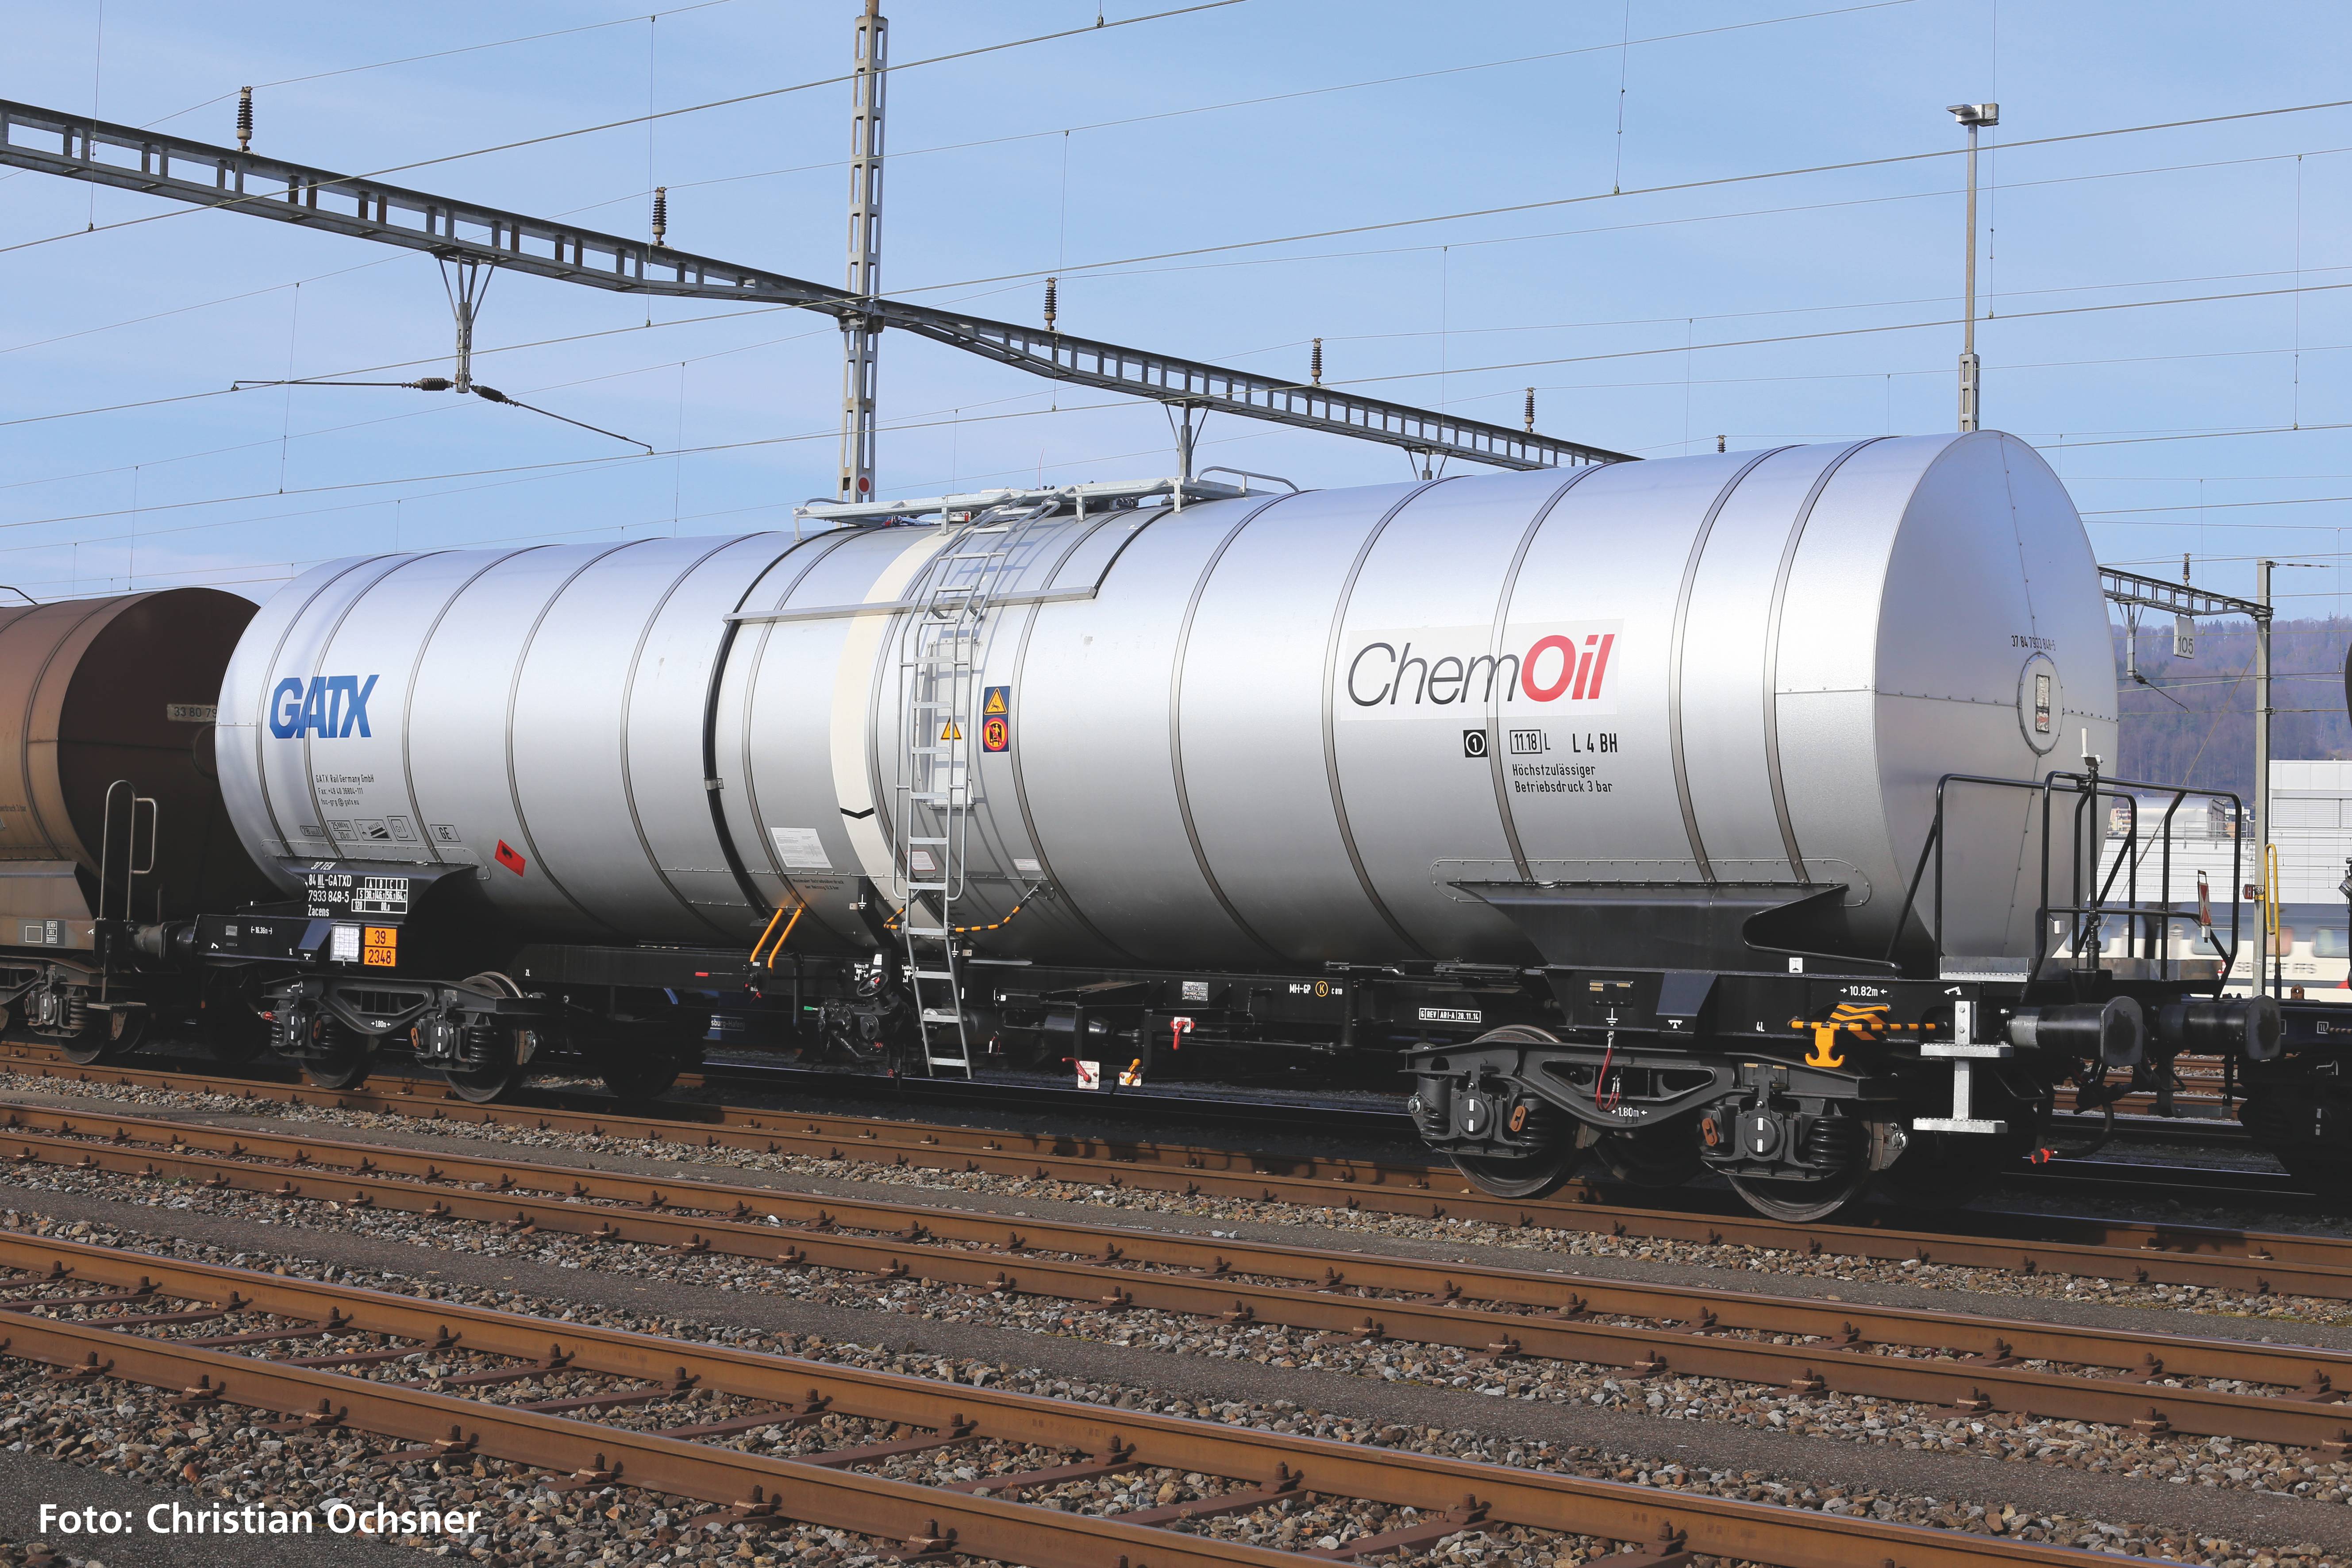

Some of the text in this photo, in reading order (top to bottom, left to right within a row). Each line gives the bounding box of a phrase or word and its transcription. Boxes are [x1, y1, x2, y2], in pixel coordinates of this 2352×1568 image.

[2011, 636, 2056, 651] 37 84 7933 848-5
[2179, 636, 2194, 655] 105
[1347, 633, 1615, 706] ChemOil
[174, 707, 186, 717] 33
[189, 707, 201, 717] 80
[269, 674, 380, 739] GATX
[1514, 733, 1551, 751] 11.18 L
[1573, 733, 1618, 753] L 4 BH
[1512, 763, 1596, 779] Höchstzulässiger
[339, 774, 360, 785] Germany
[361, 774, 374, 782] GmbH
[1515, 781, 1613, 793] Betriebsdruck 3 bar
[439, 827, 452, 840] GE
[308, 874, 352, 887] 84 NL-GATXD
[369, 879, 404, 889] A B C D
[308, 890, 350, 903] 7933 848-5
[2248, 886, 2252, 897] H
[308, 905, 329, 917] Zacens
[375, 930, 386, 944] 39
[368, 949, 391, 964] 2348
[2267, 962, 2289, 973] CF
[1289, 984, 1311, 994] MH-GP
[1320, 984, 1324, 994] K
[1849, 986, 1878, 997] 10.82m
[1756, 1021, 1765, 1032] 4L
[1618, 1107, 1639, 1117] 1.80m
